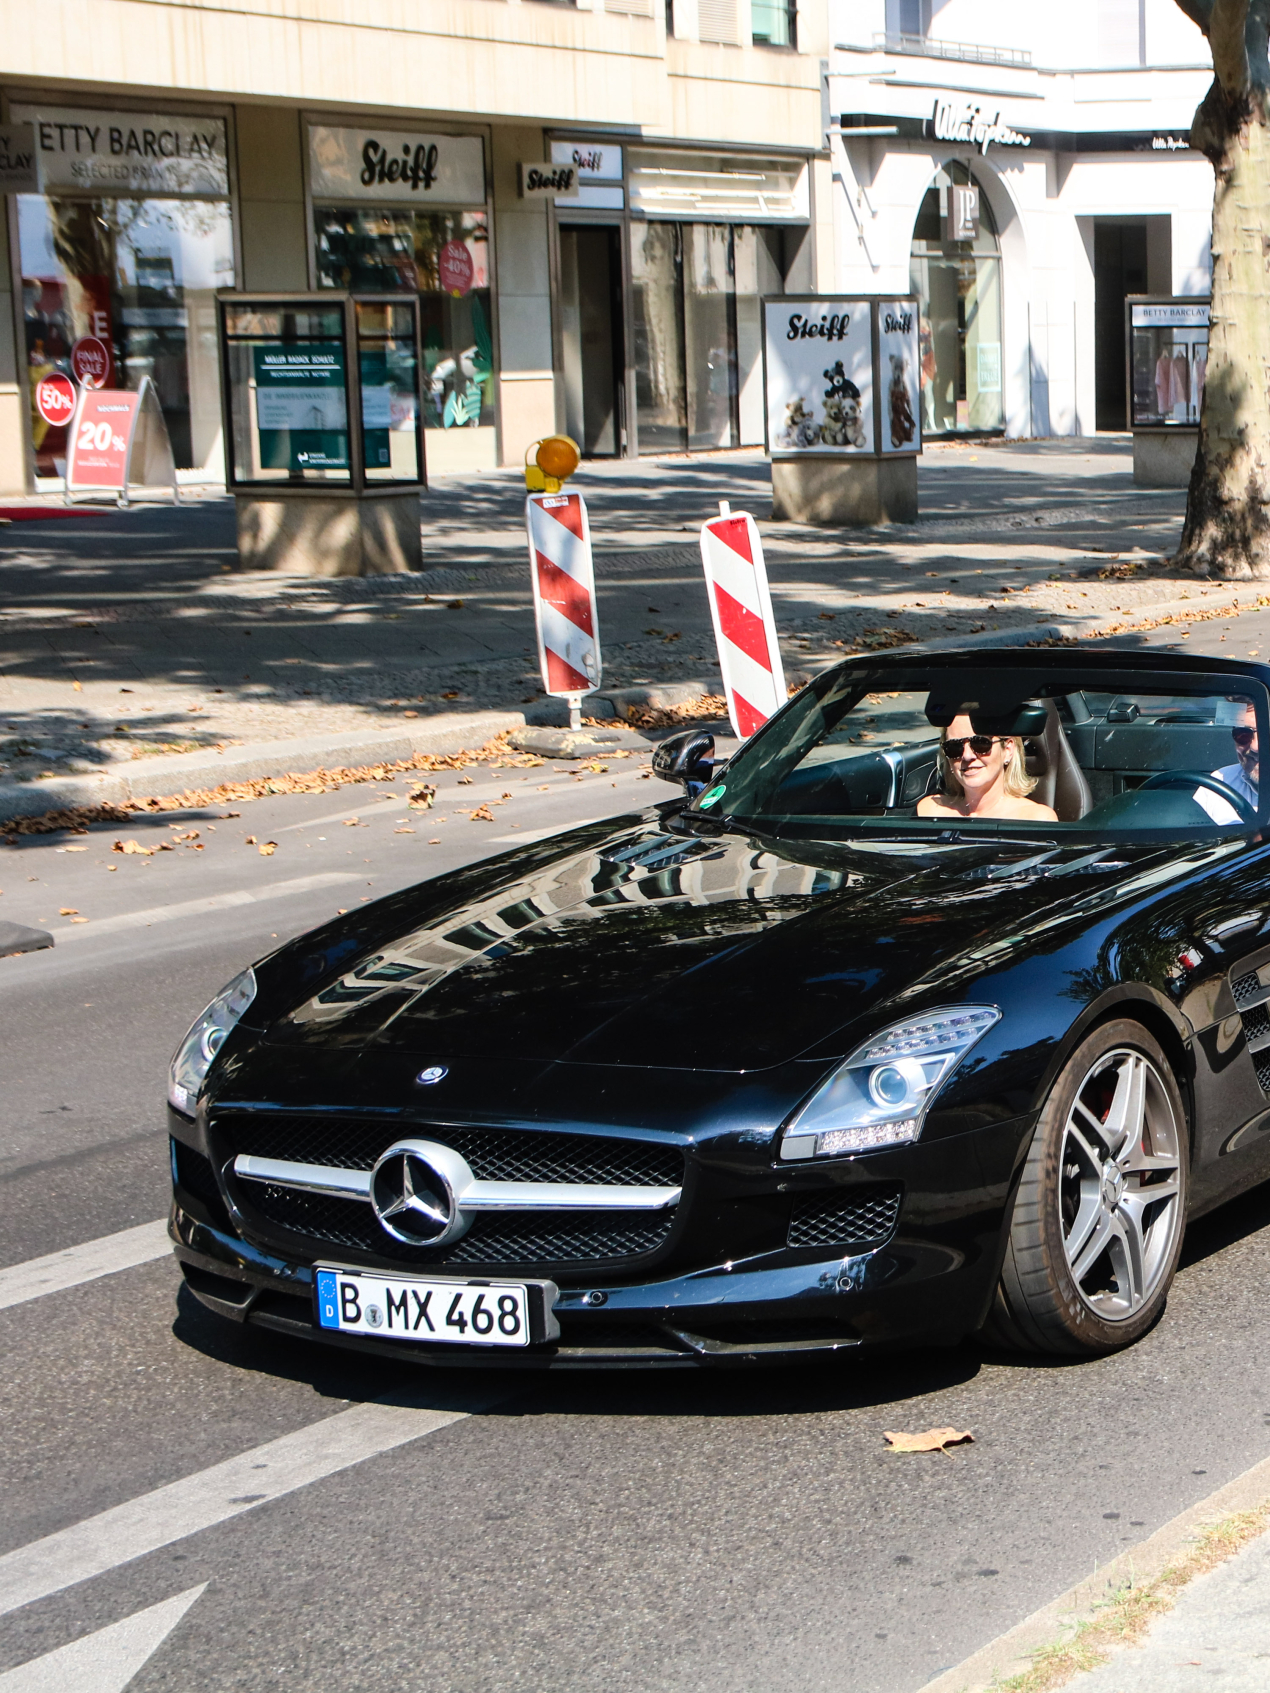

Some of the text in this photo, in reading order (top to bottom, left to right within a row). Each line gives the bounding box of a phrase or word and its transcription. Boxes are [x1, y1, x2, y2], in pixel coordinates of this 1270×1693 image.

[39, 122, 100, 152] ETTY
[108, 126, 218, 160] BARCLAY
[71, 161, 130, 180] SELECTED
[360, 139, 438, 190] Steiff
[572, 149, 603, 172] Steiff
[526, 168, 575, 191] Steiff
[958, 189, 976, 230] JP
[447, 244, 468, 261] Sale
[884, 312, 913, 334] Steiff
[1143, 308, 1207, 317] BETTY BARCLAY
[786, 313, 850, 342] Steiff
[76, 350, 104, 363] FINAL
[79, 363, 104, 375] SALE
[41, 388, 74, 409] 50%
[325, 1304, 334, 1318] D
[340, 1282, 521, 1336] B MX 468
